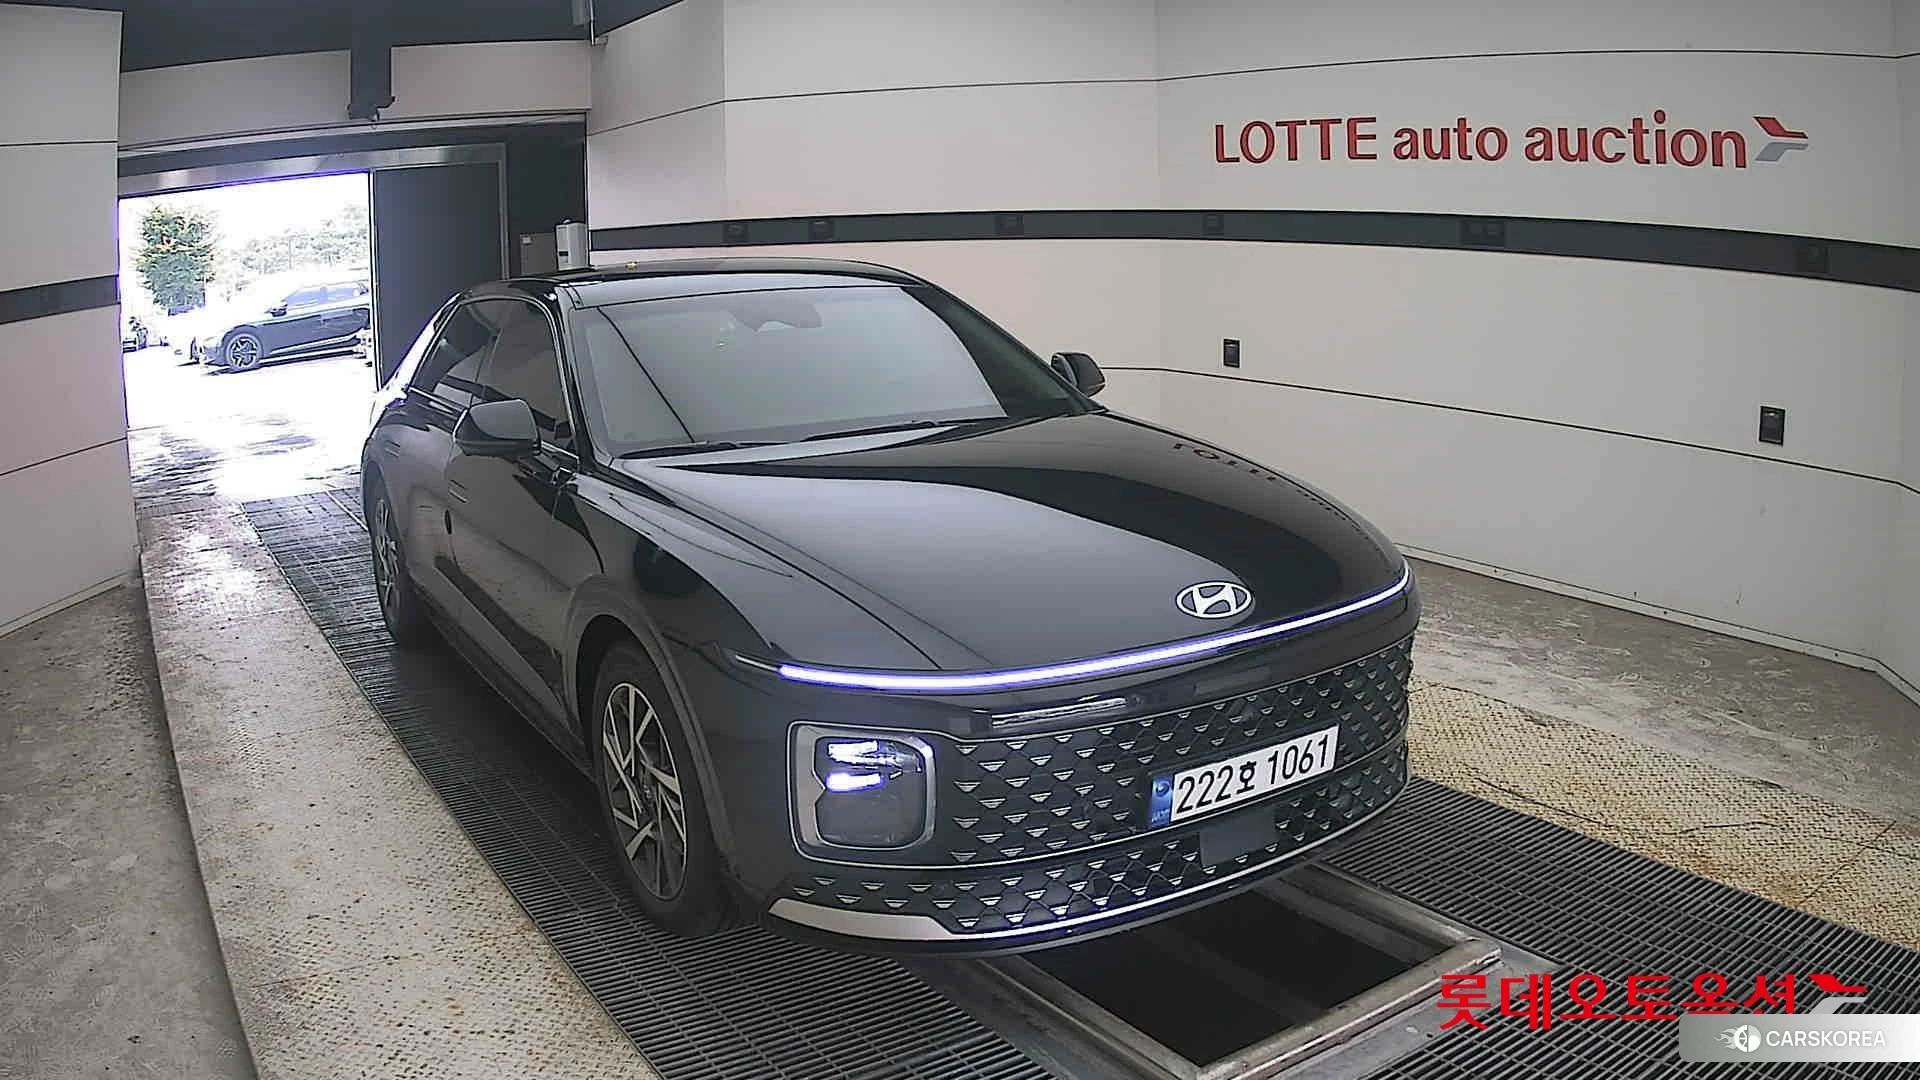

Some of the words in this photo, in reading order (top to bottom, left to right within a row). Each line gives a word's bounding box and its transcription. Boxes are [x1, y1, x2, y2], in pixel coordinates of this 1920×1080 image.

[1215, 116, 1377, 164] LOTTE
[1393, 117, 1508, 161] auto
[1525, 110, 1747, 168] auction
[1176, 760, 1257, 814] 222호
[1267, 734, 1329, 785] 1061
